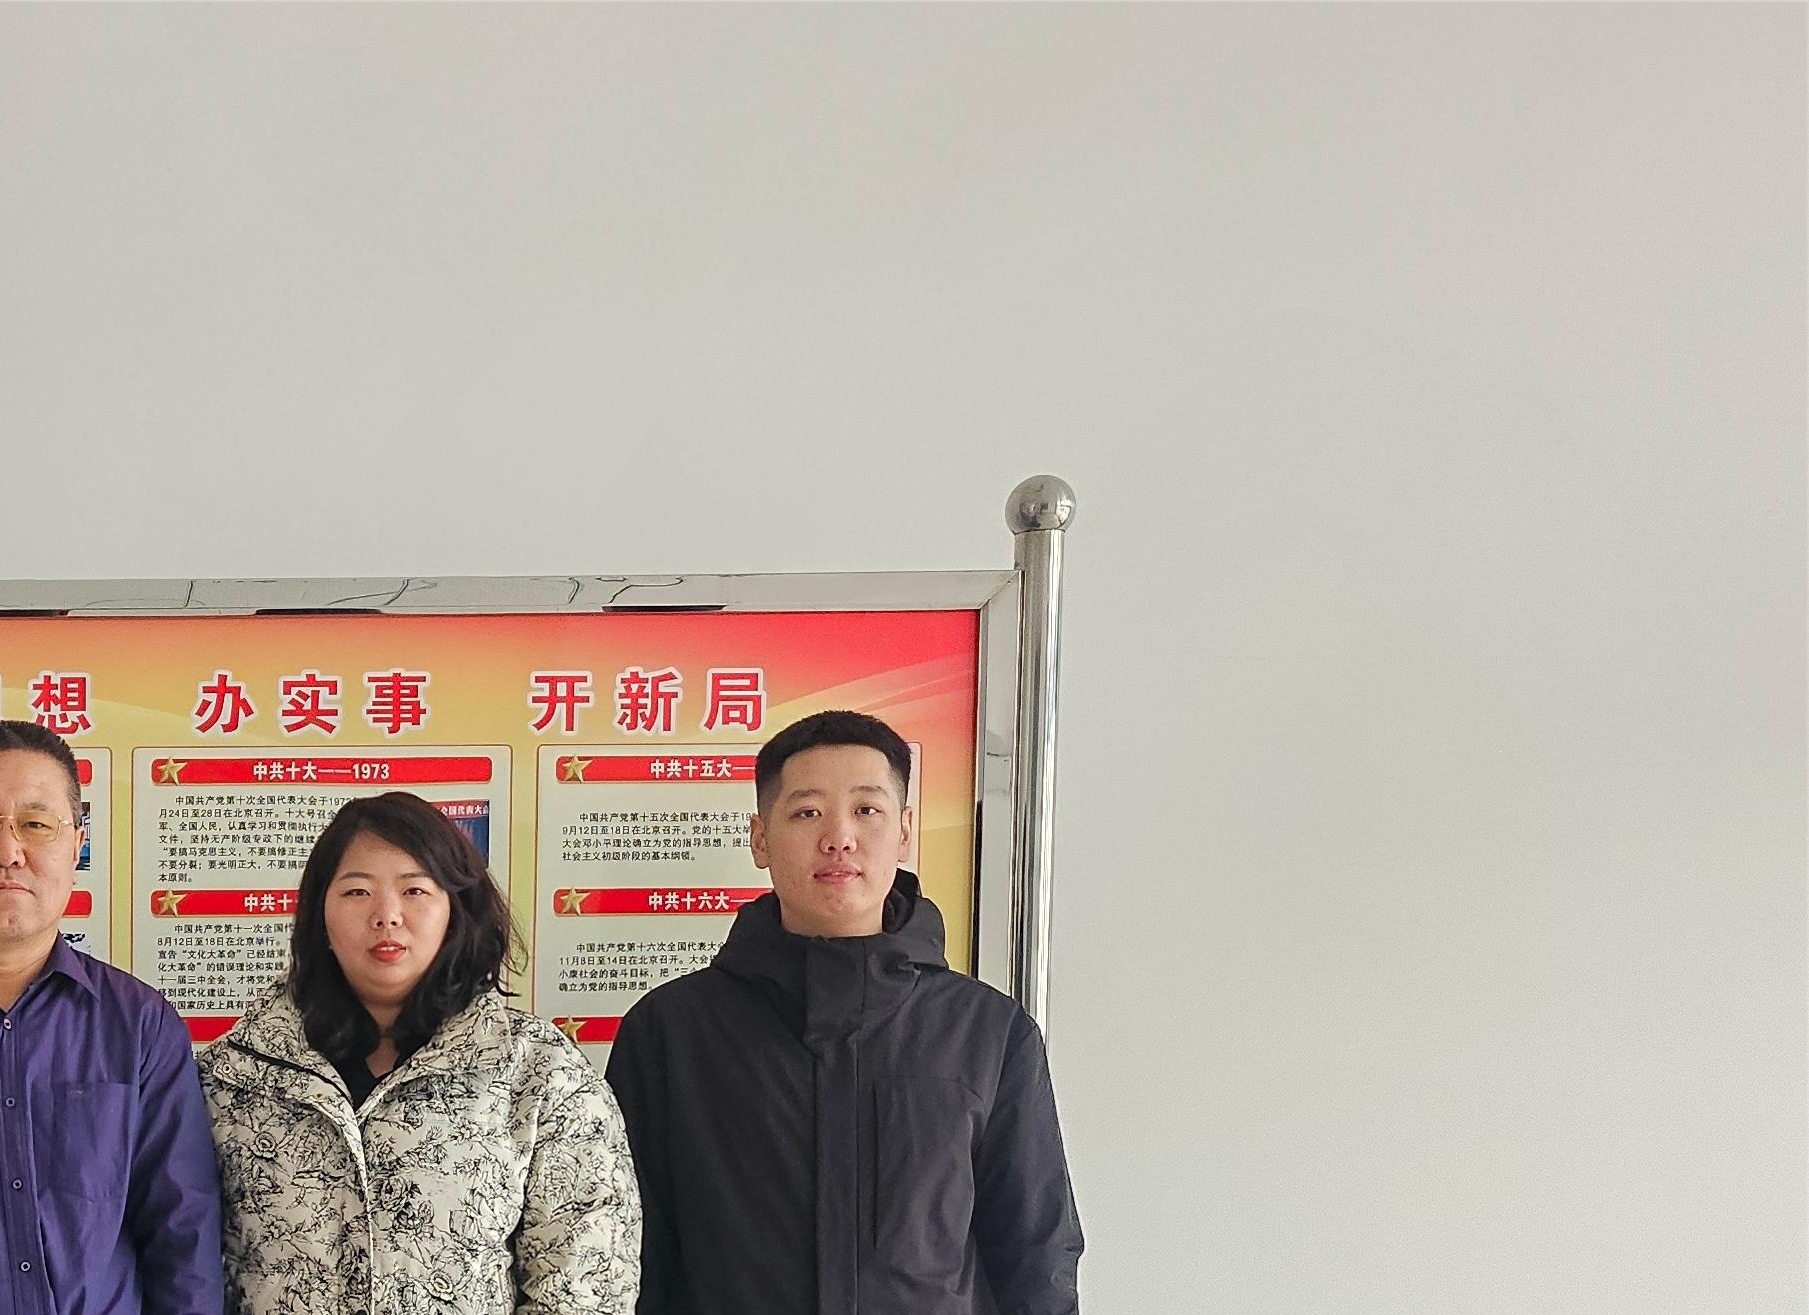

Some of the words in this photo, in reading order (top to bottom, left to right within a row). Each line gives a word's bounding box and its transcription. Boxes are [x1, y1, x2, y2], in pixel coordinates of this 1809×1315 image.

[194, 671, 428, 735] 办实事
[531, 668, 765, 733] 开新局
